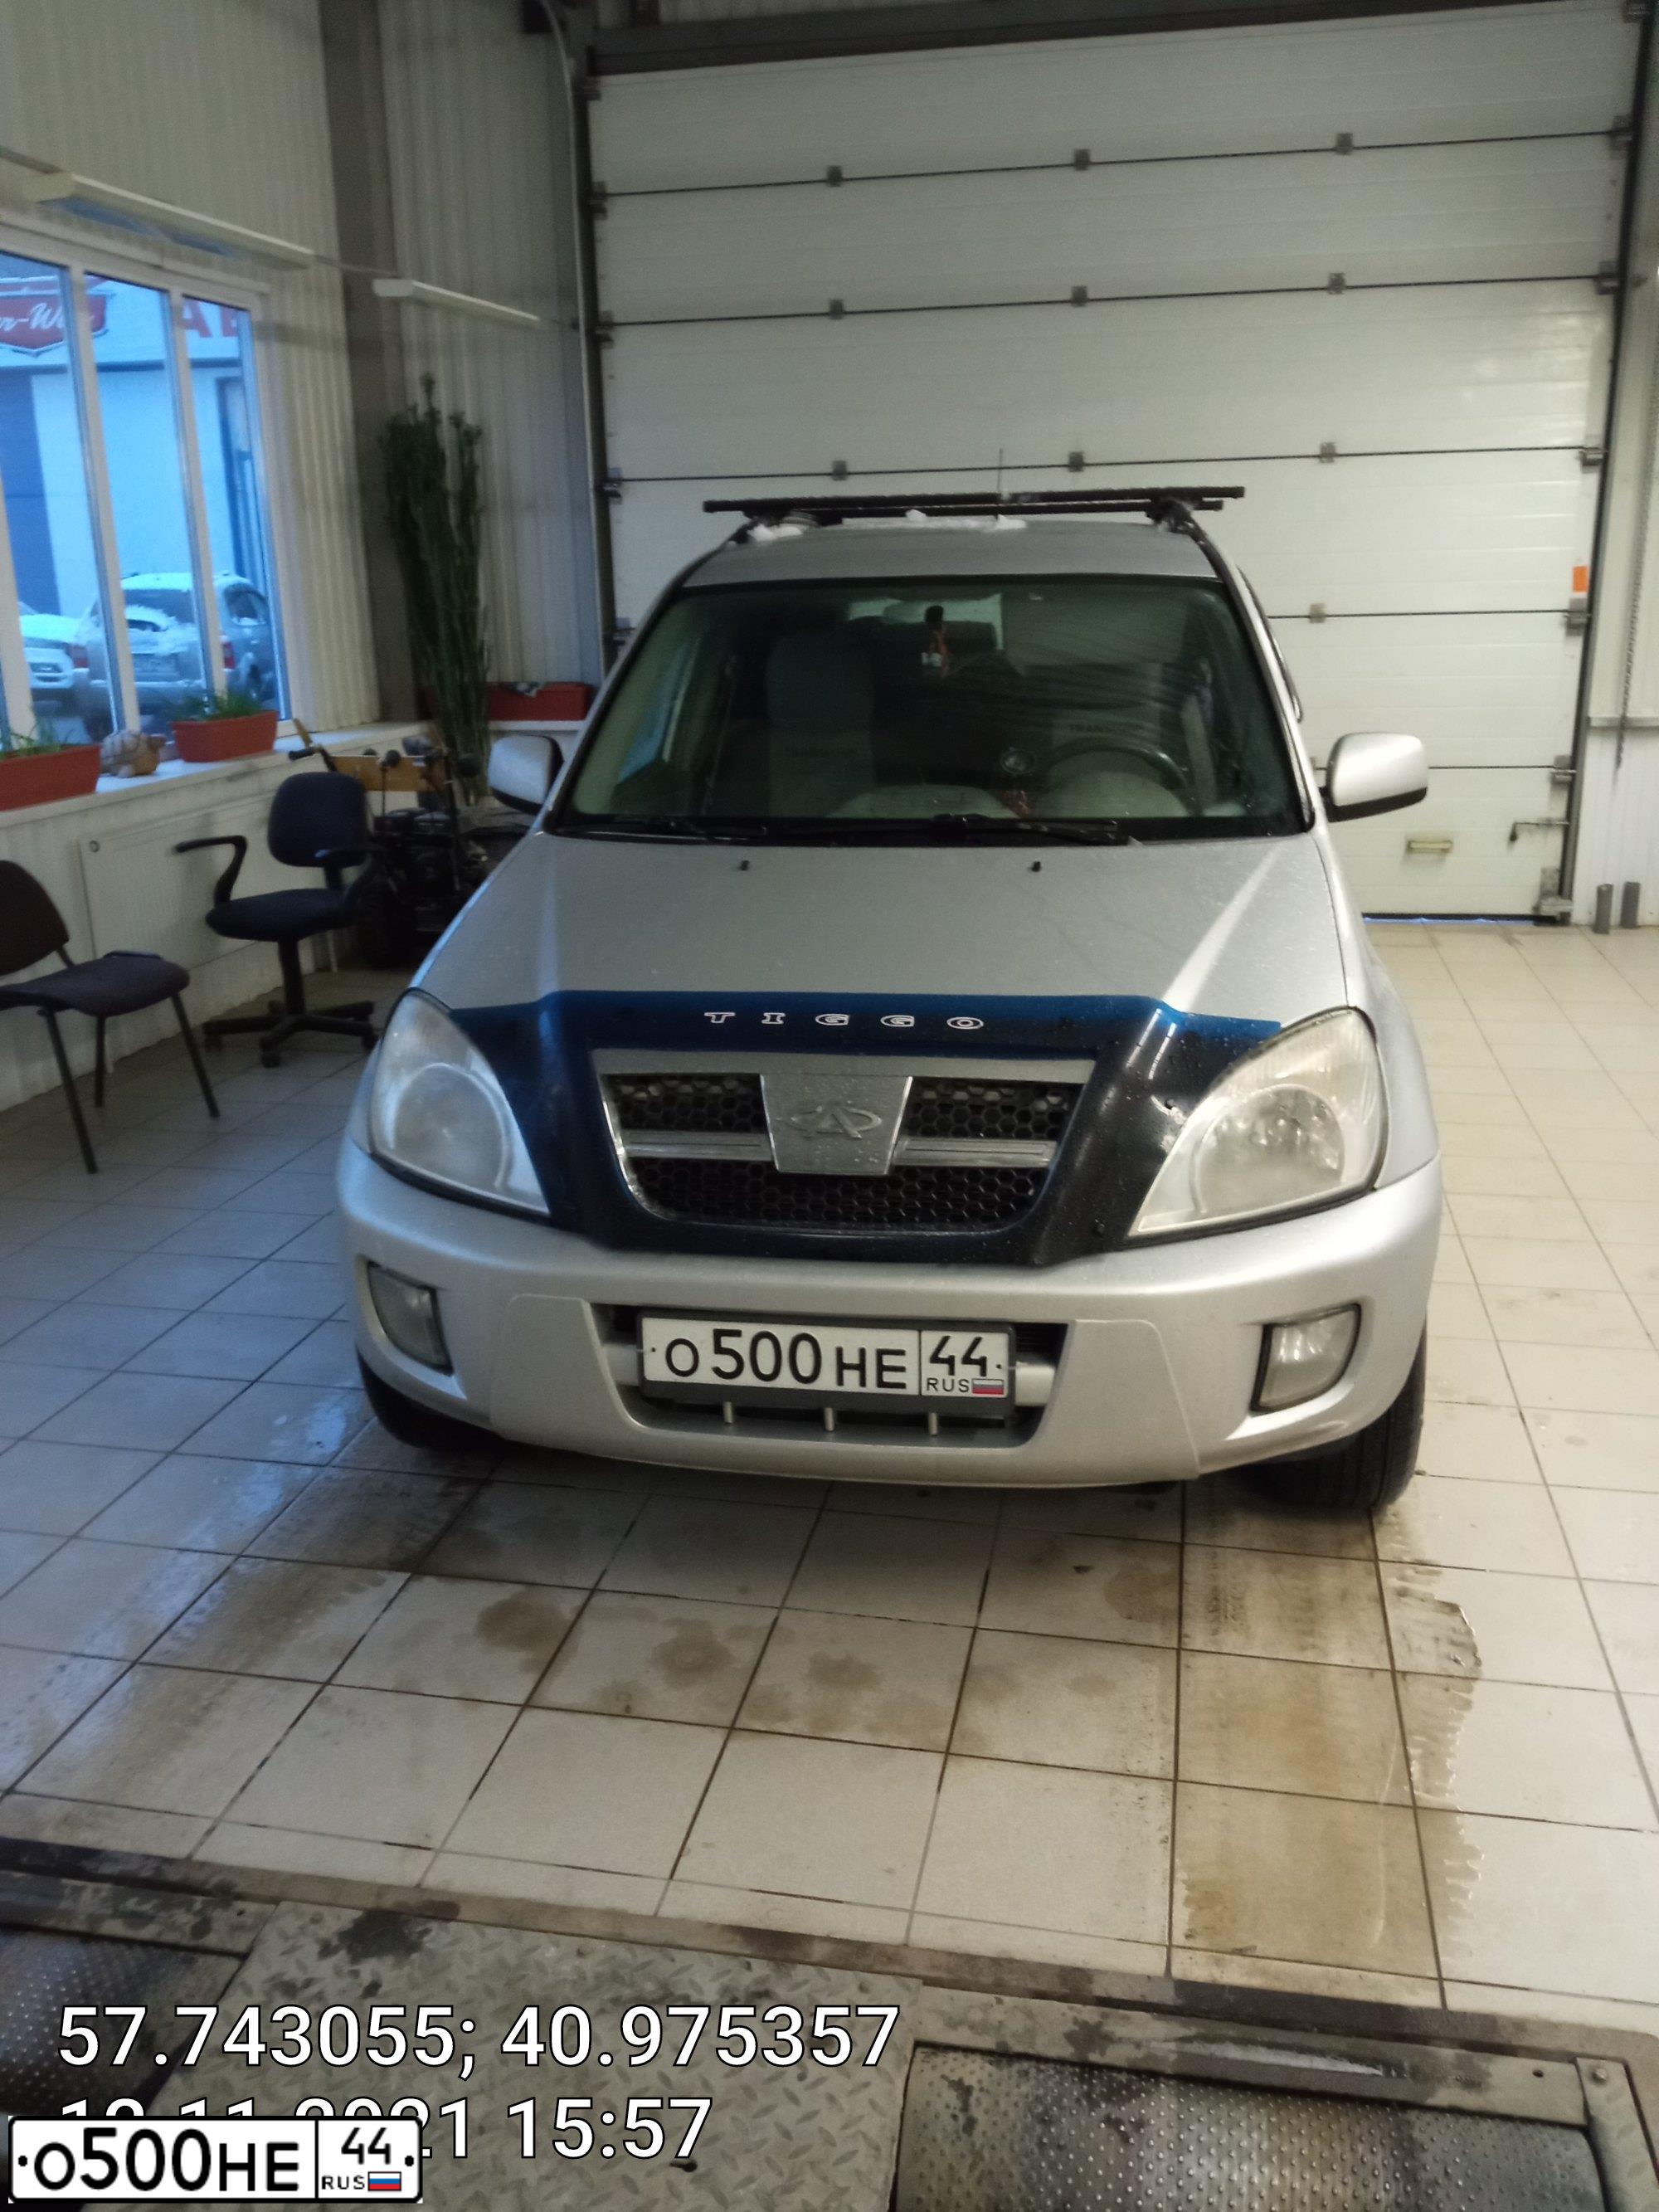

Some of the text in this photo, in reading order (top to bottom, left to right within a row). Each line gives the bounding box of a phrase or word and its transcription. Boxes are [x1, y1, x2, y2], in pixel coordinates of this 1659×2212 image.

[704, 1011, 984, 1030] TIGGO
[929, 1335, 988, 1376] 44
[927, 1377, 970, 1393] RUS
